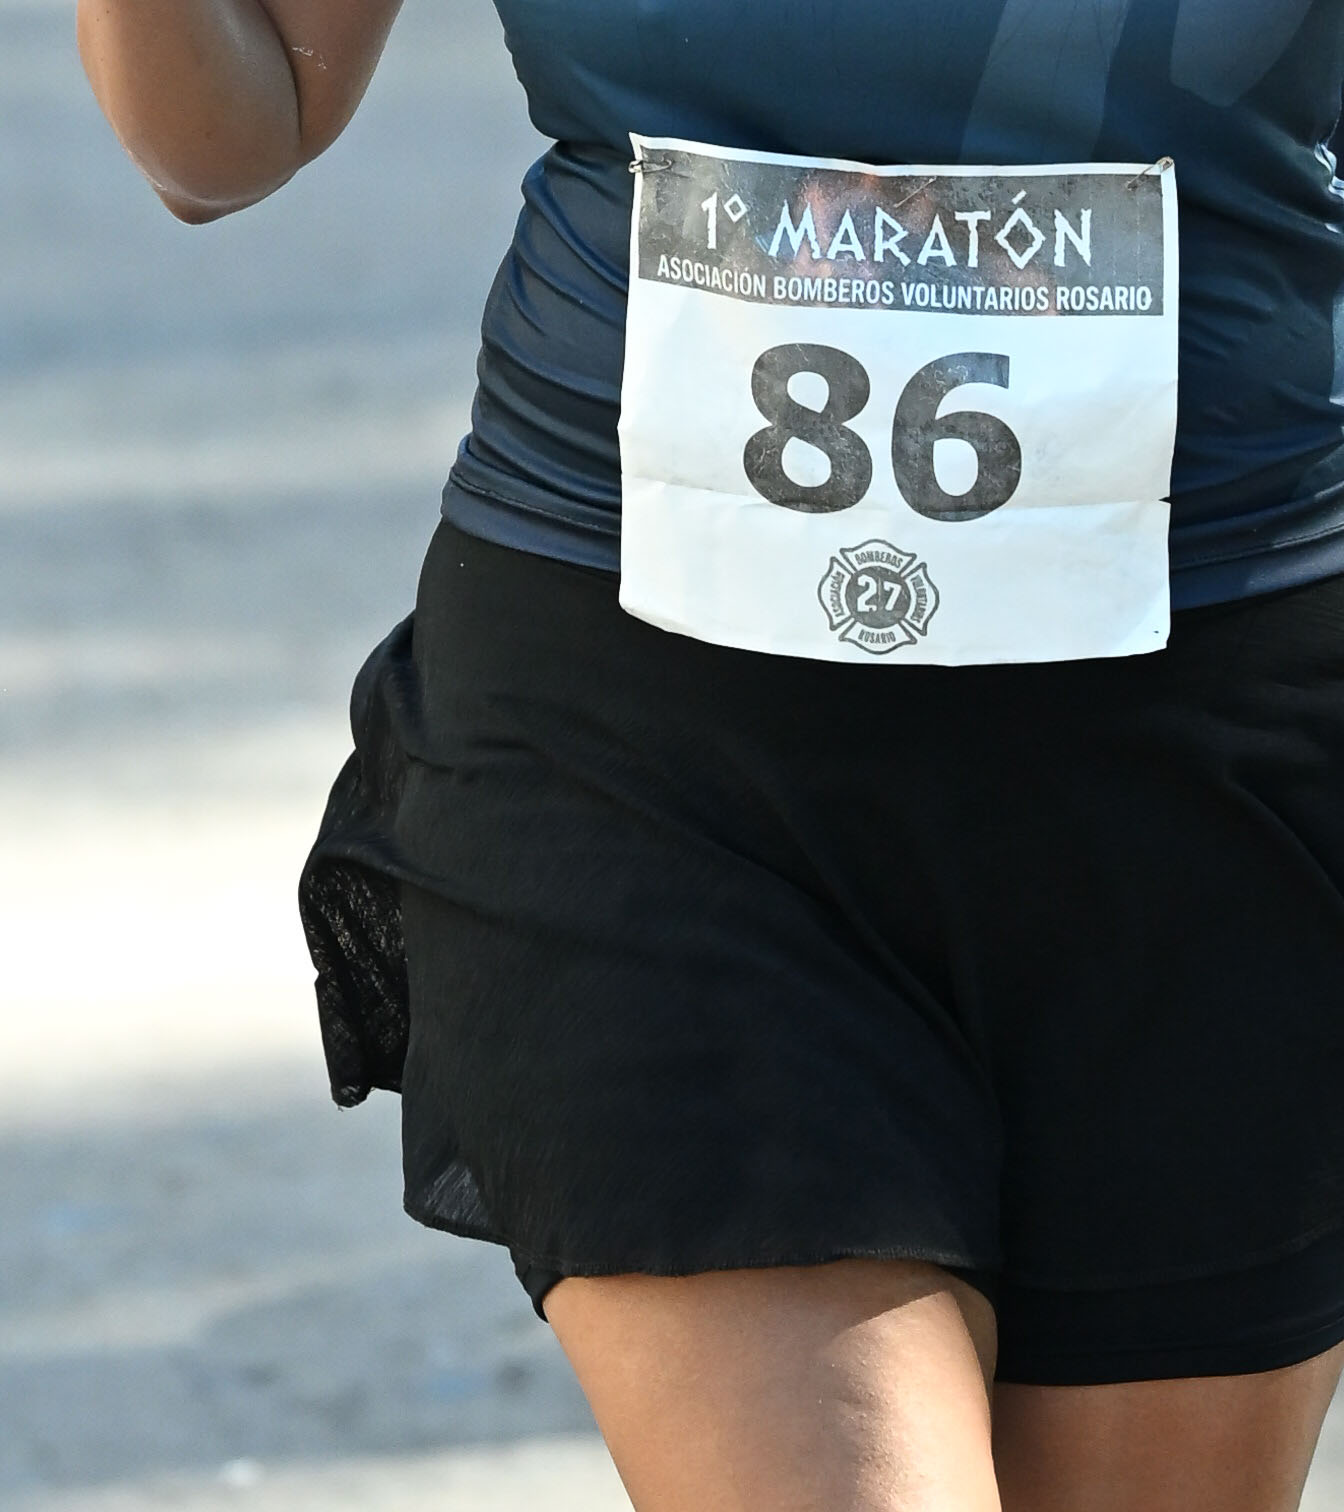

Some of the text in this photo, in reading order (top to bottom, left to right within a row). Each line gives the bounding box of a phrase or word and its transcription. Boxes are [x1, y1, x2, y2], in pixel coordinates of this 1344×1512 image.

[768, 189, 1092, 270] MARATÓN
[657, 254, 1153, 312] ASOCIACIÓN BOMBEROS VOLUNTARIOS ROSARIO
[743, 342, 1022, 523] 86
[855, 551, 903, 568] BOMBEROS
[856, 574, 902, 613] 27
[858, 629, 896, 644] ROSARIO
